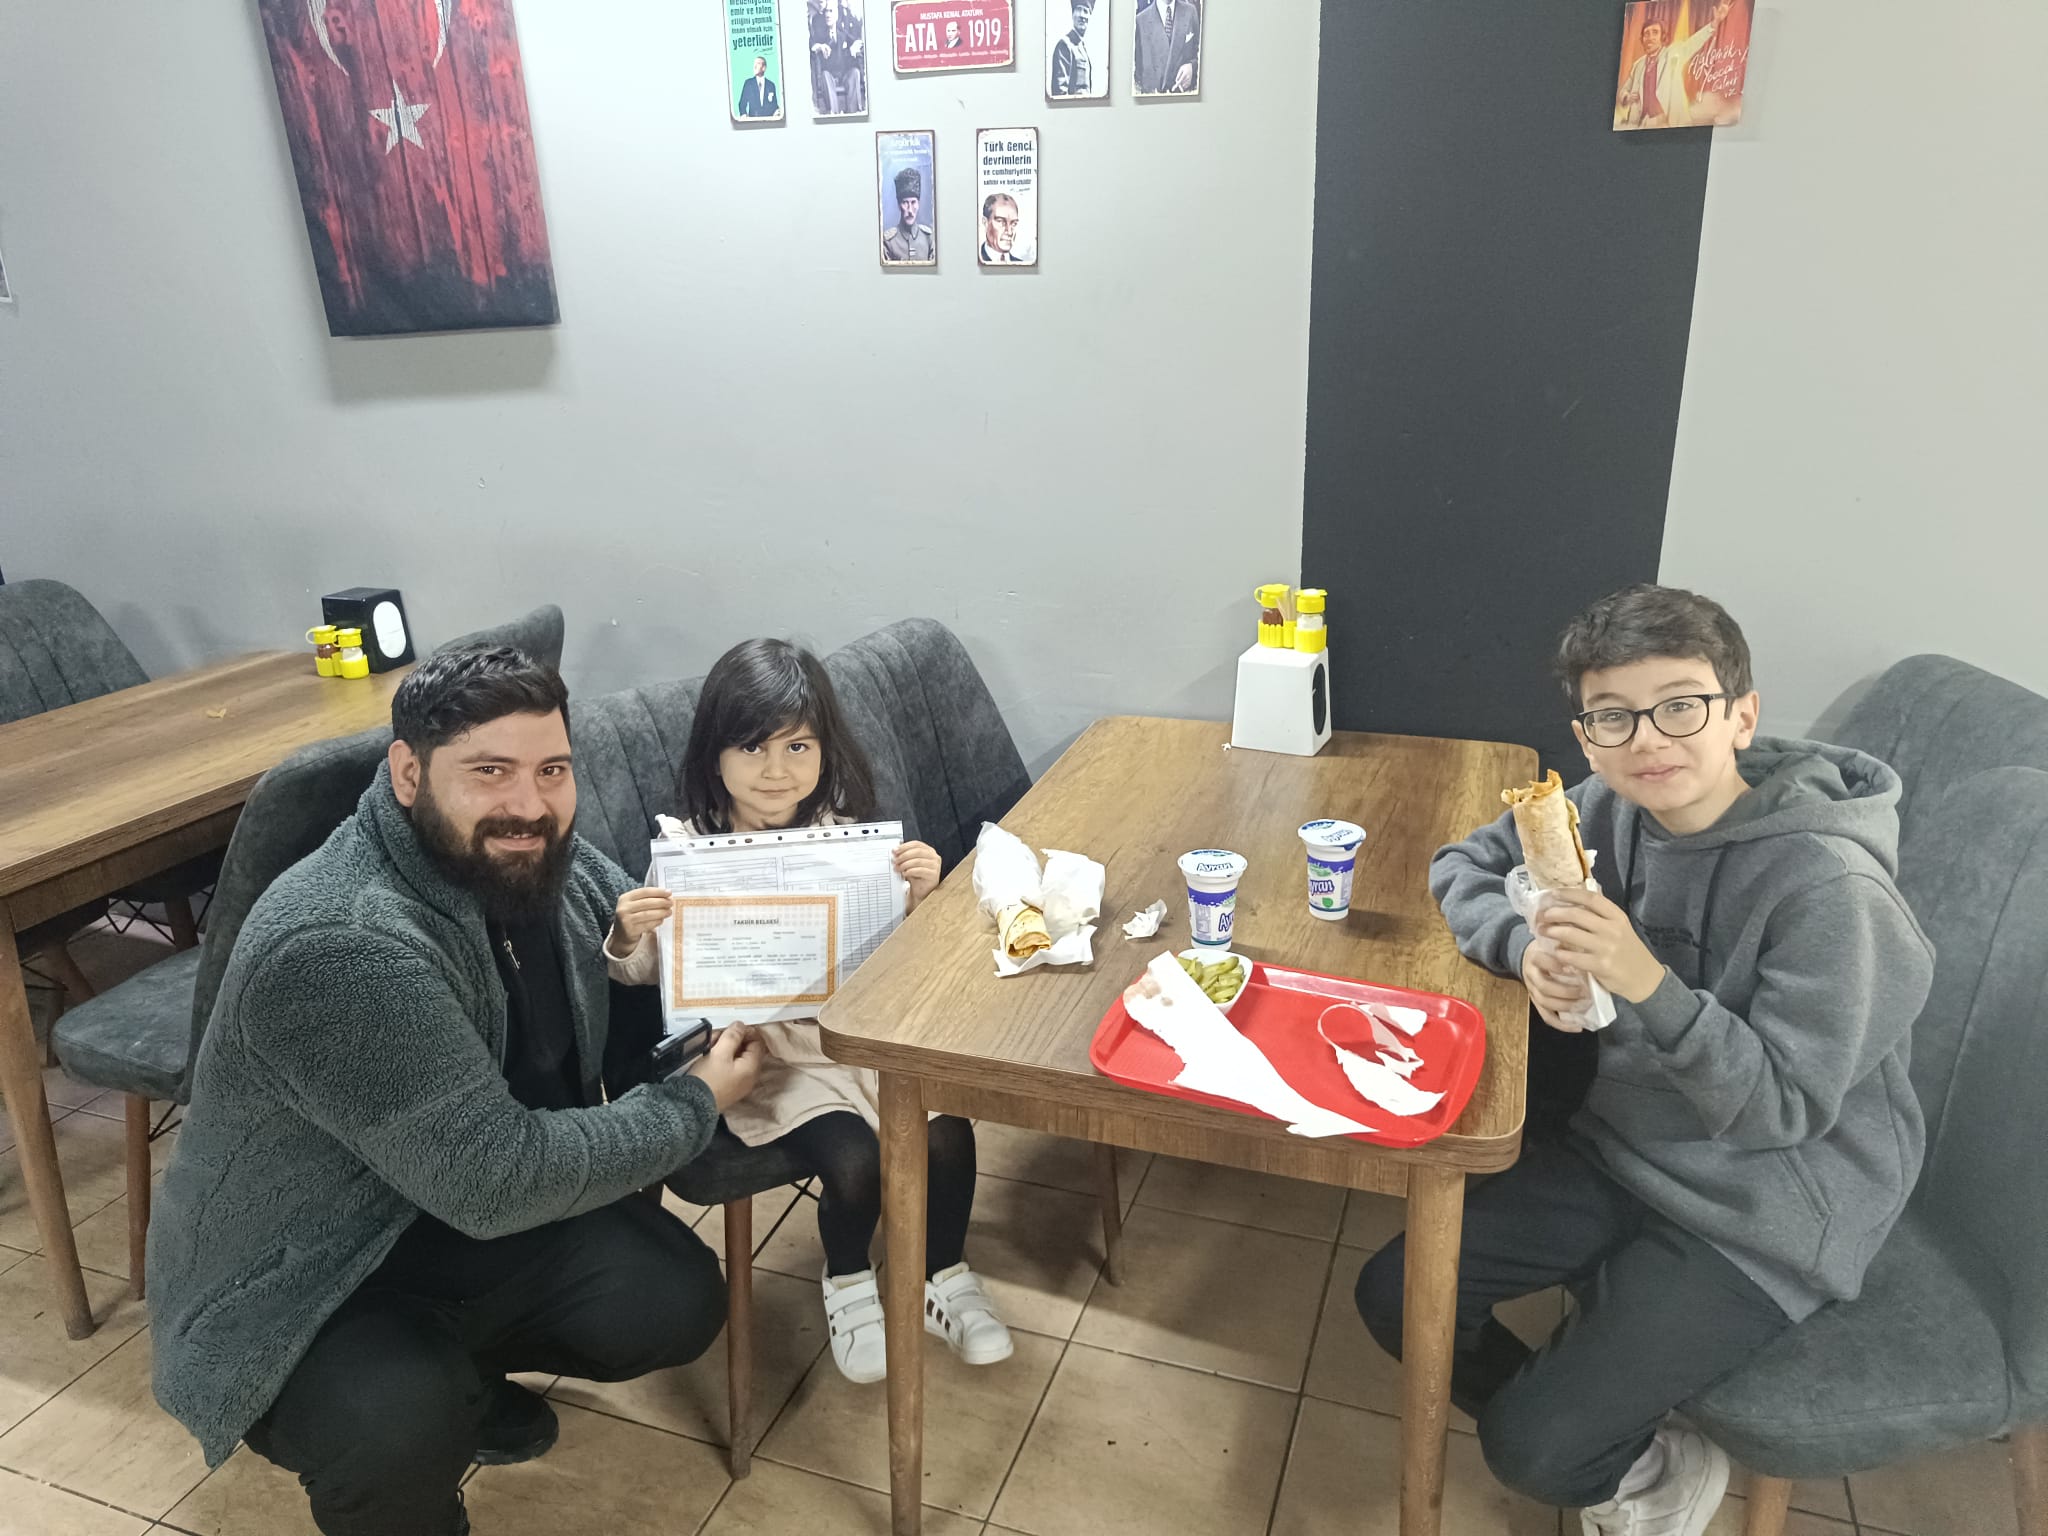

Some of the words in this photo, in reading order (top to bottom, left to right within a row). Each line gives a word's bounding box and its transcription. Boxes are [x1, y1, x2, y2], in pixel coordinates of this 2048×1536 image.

[920, 11, 943, 20] MUSTAFA
[943, 10, 961, 18] KEMAL
[905, 22, 938, 53] ATA
[968, 18, 1002, 48] 1919
[732, 34, 773, 50] yeterlidir
[984, 140, 1004, 152] Türk
[1007, 140, 1032, 152] Genci
[983, 154, 1032, 165] devrimlerin
[1196, 862, 1234, 873] Ayran
